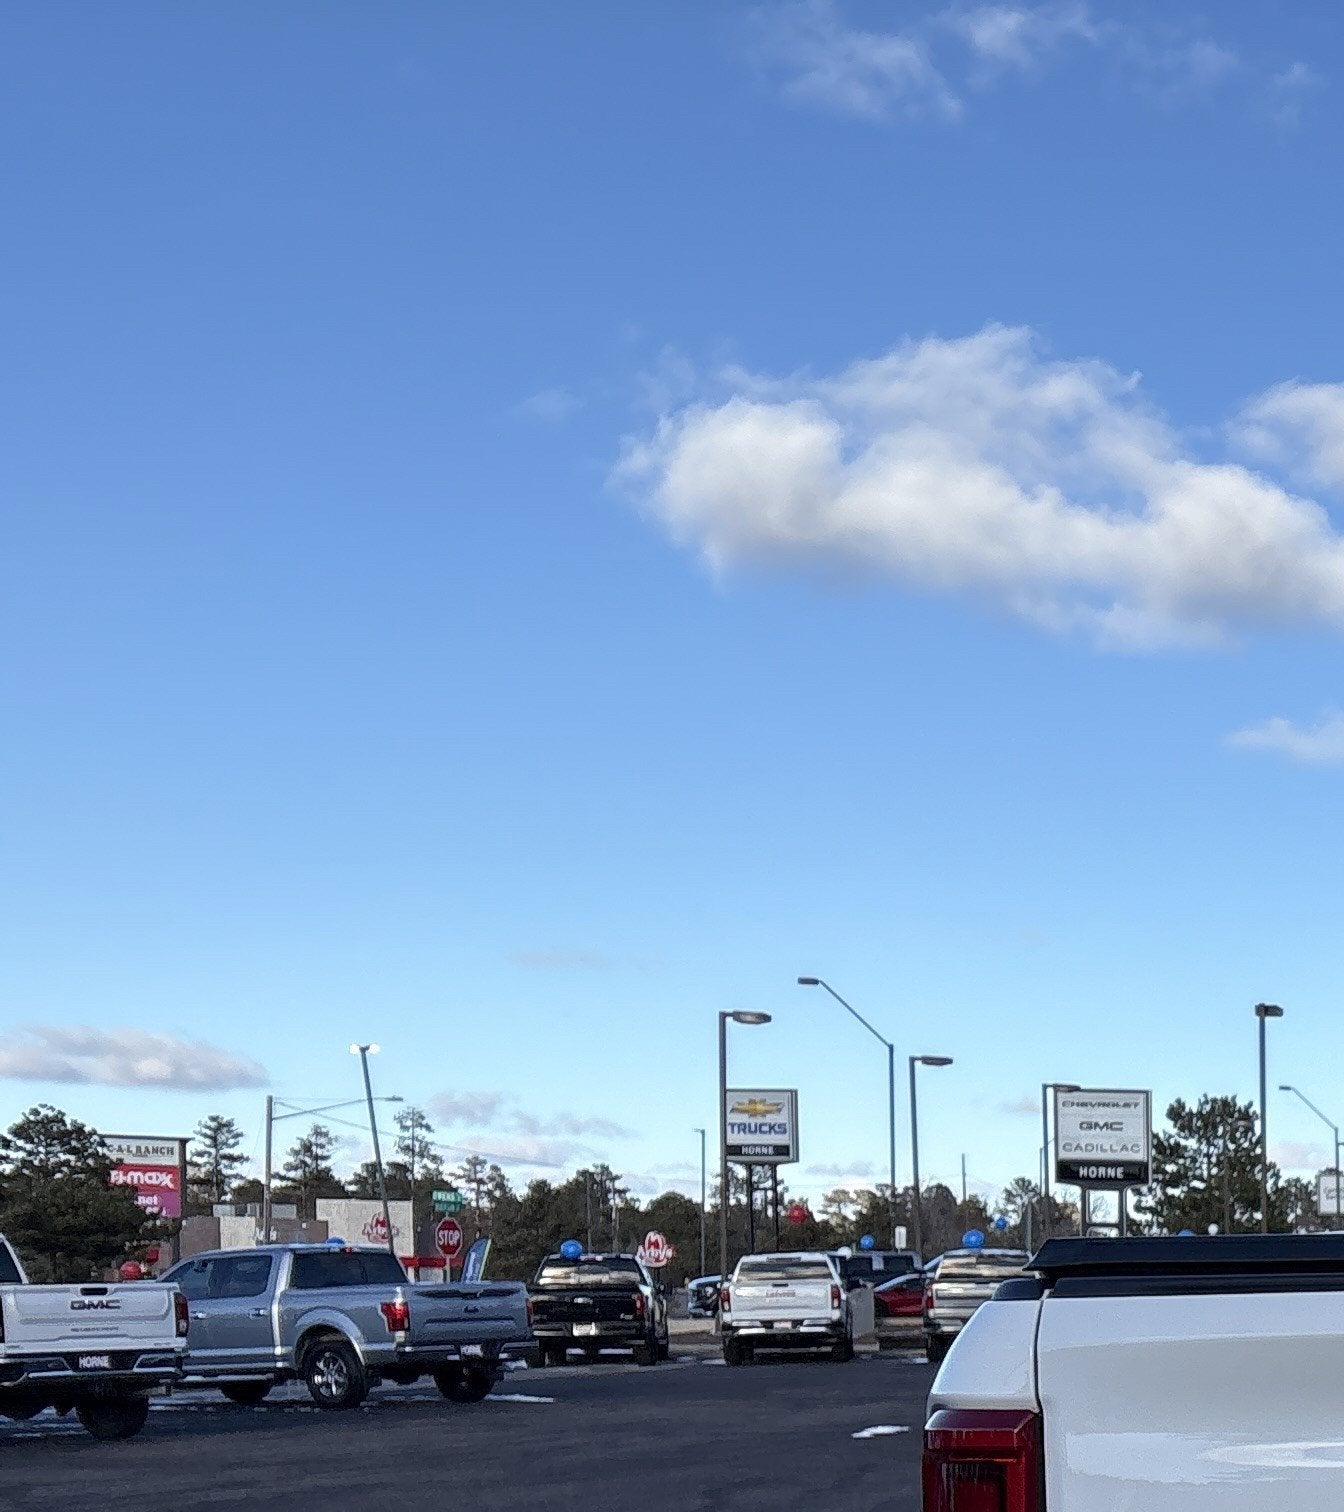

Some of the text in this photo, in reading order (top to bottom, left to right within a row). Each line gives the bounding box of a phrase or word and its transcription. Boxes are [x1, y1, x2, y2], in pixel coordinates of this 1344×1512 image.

[728, 1122, 787, 1135] TRUCKS
[1079, 1121, 1123, 1131] GMC
[135, 1145, 175, 1155] RANCH
[742, 1145, 774, 1155] HORNE
[1062, 1142, 1140, 1153] CADILLAC
[1079, 1166, 1124, 1179] HORNE
[438, 1229, 461, 1247] STOP
[70, 1300, 122, 1310] GMC
